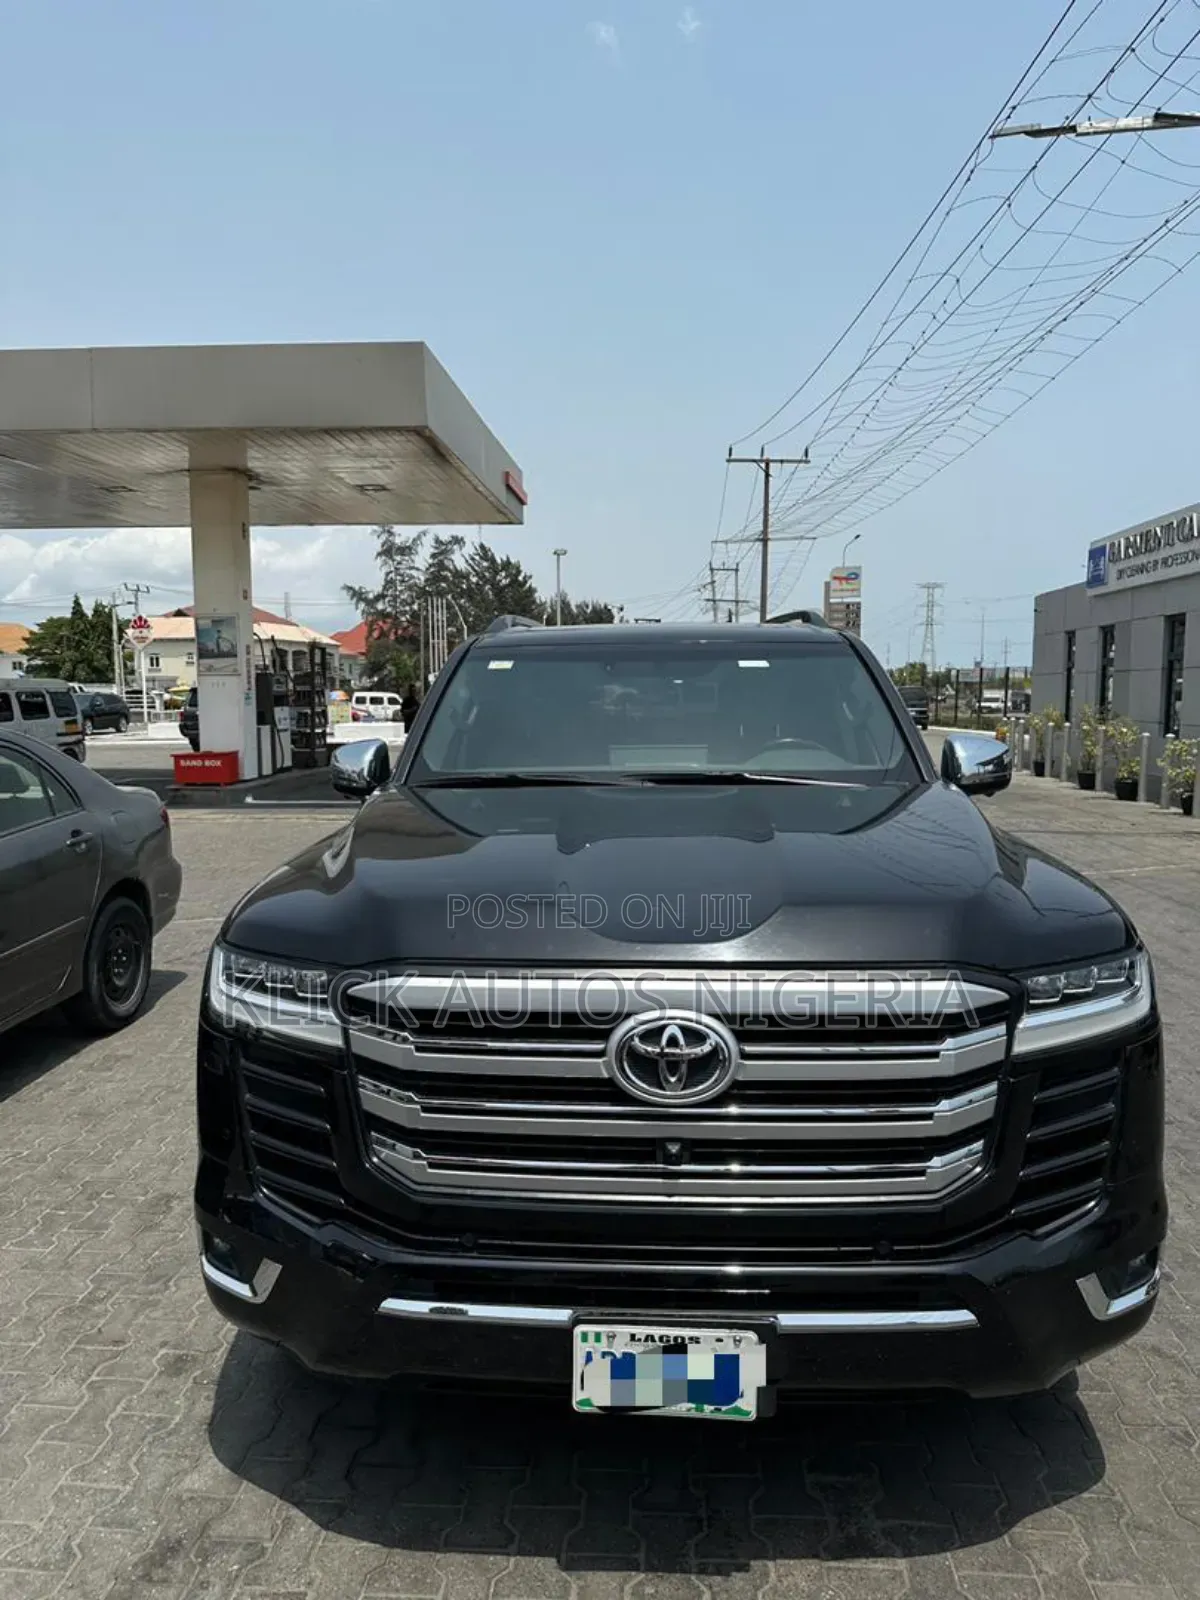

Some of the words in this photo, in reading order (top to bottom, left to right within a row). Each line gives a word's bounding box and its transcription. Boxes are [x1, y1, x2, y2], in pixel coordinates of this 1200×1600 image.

[180, 759, 202, 767] SAND
[204, 759, 222, 767] BOX
[629, 1333, 702, 1345] LAGOS
